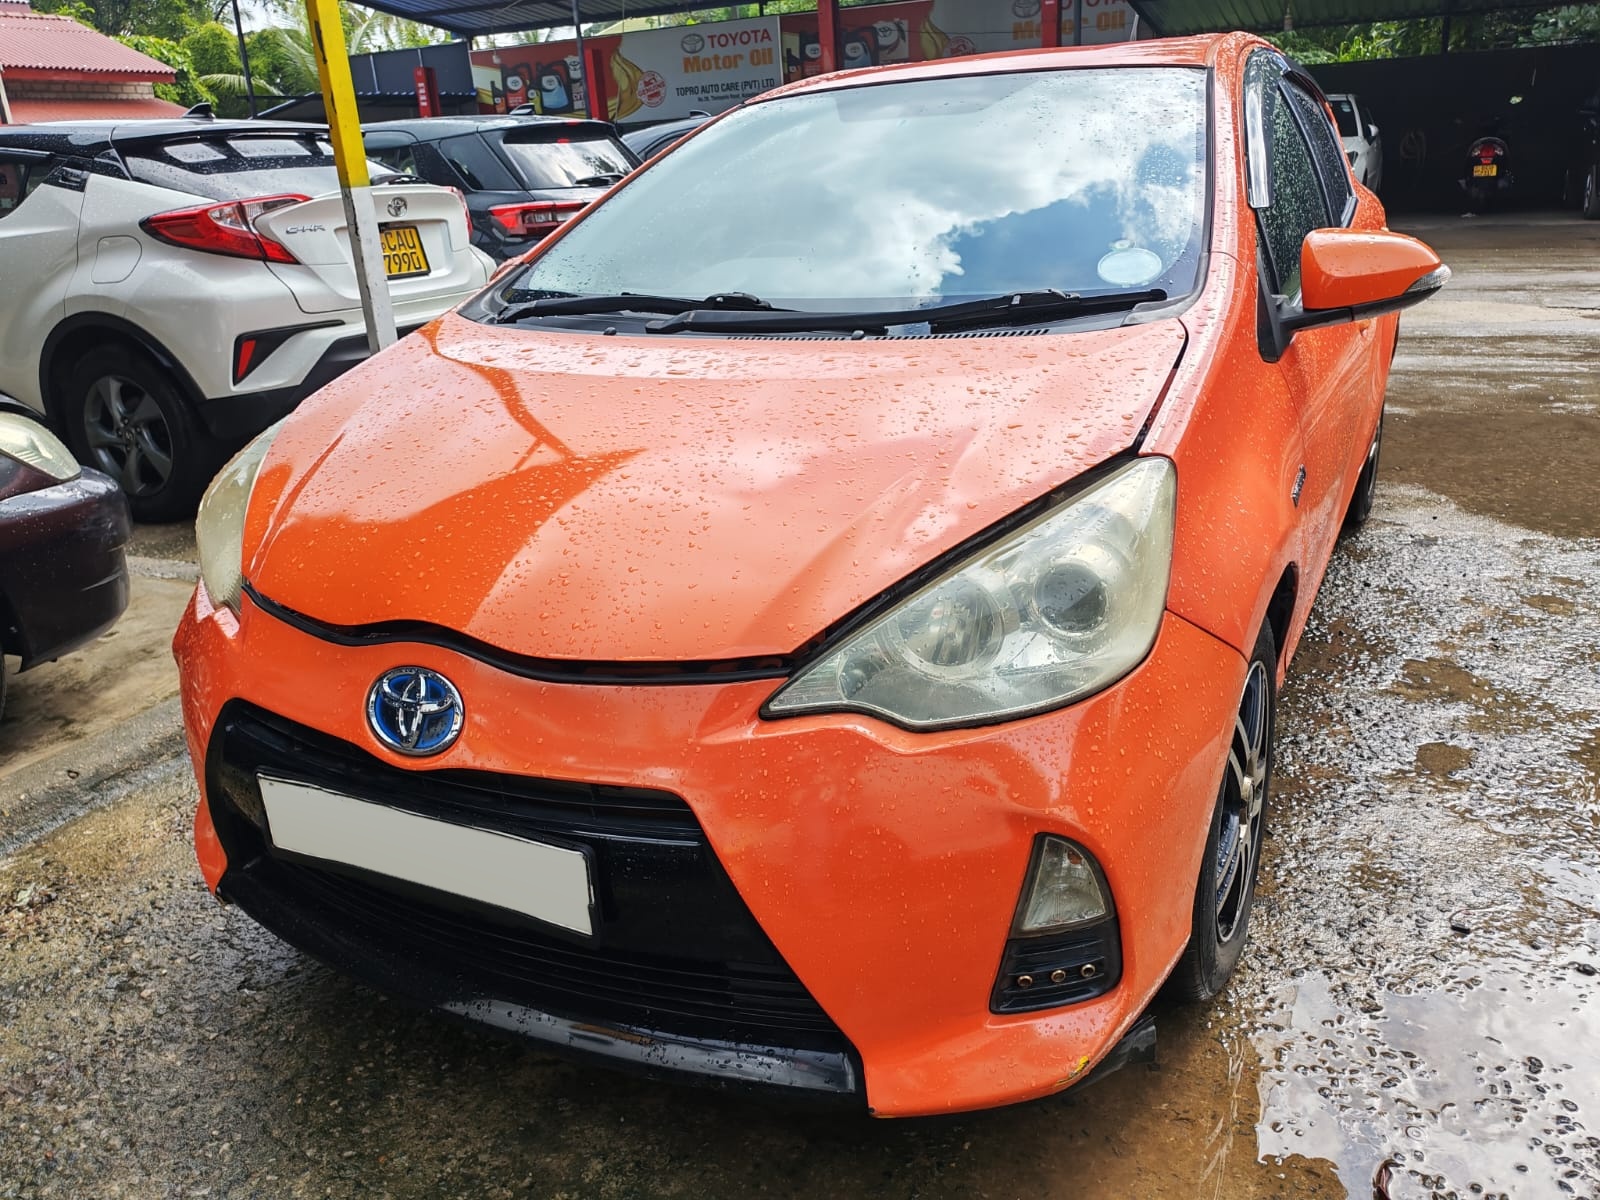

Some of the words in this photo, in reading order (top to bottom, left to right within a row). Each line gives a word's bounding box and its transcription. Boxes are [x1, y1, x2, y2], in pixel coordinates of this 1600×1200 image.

[707, 28, 773, 49] TOYOTA
[683, 53, 744, 73] Motor
[749, 48, 773, 67] Oil
[675, 86, 699, 97] TOPRO
[701, 83, 719, 94] AUTO
[721, 81, 740, 92] CARE
[741, 79, 760, 91] (PVT)
[761, 78, 775, 89] LTD
[384, 230, 416, 251] CAU
